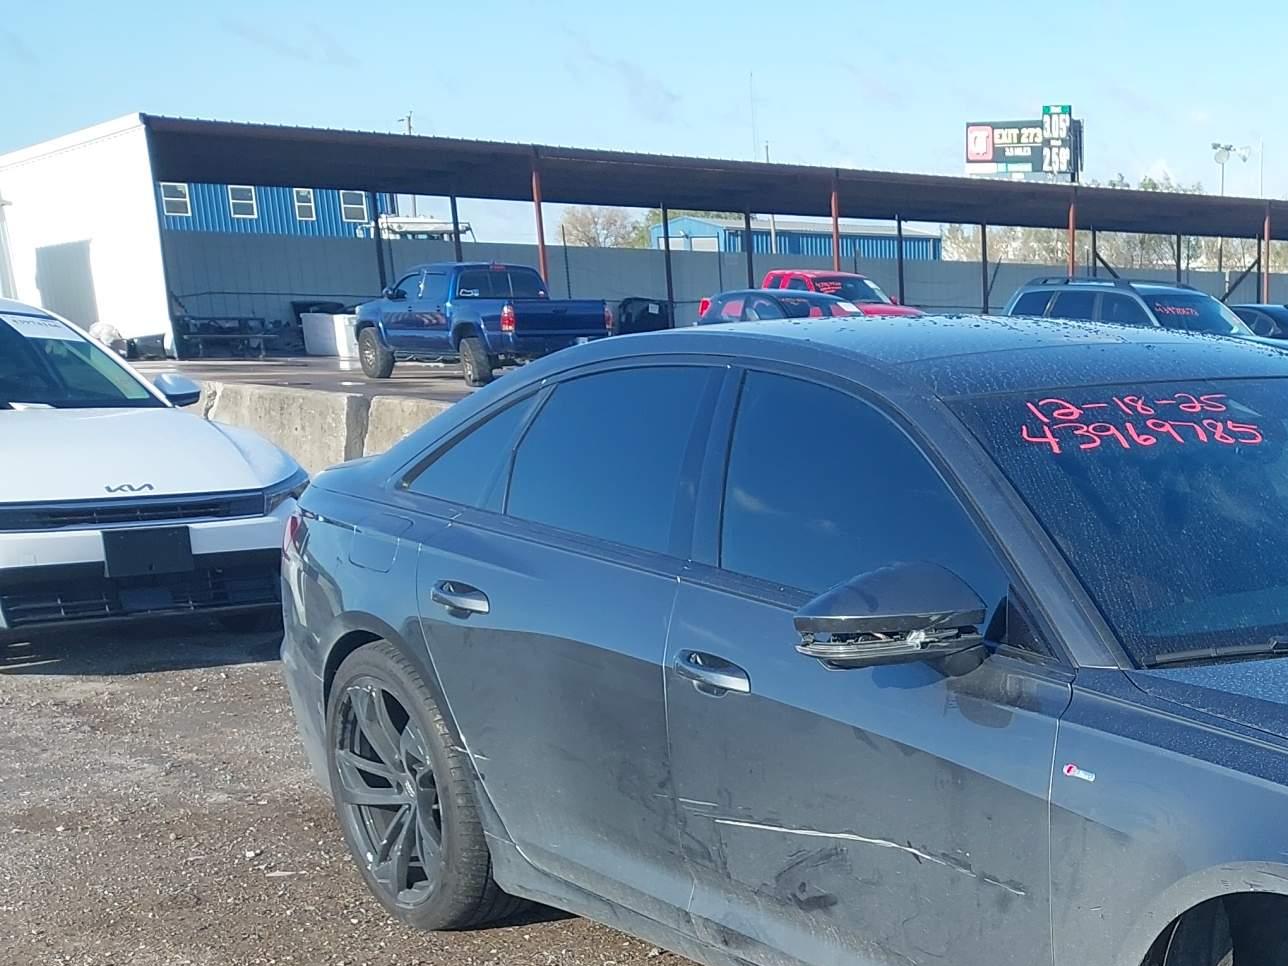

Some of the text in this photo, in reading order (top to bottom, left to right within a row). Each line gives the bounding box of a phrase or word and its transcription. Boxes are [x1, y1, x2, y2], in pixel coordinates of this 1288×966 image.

[994, 128, 1019, 143] EXIT
[1020, 127, 1042, 143] 273
[1026, 393, 1227, 423] 12-18-25
[1021, 418, 1263, 454] 43969785
